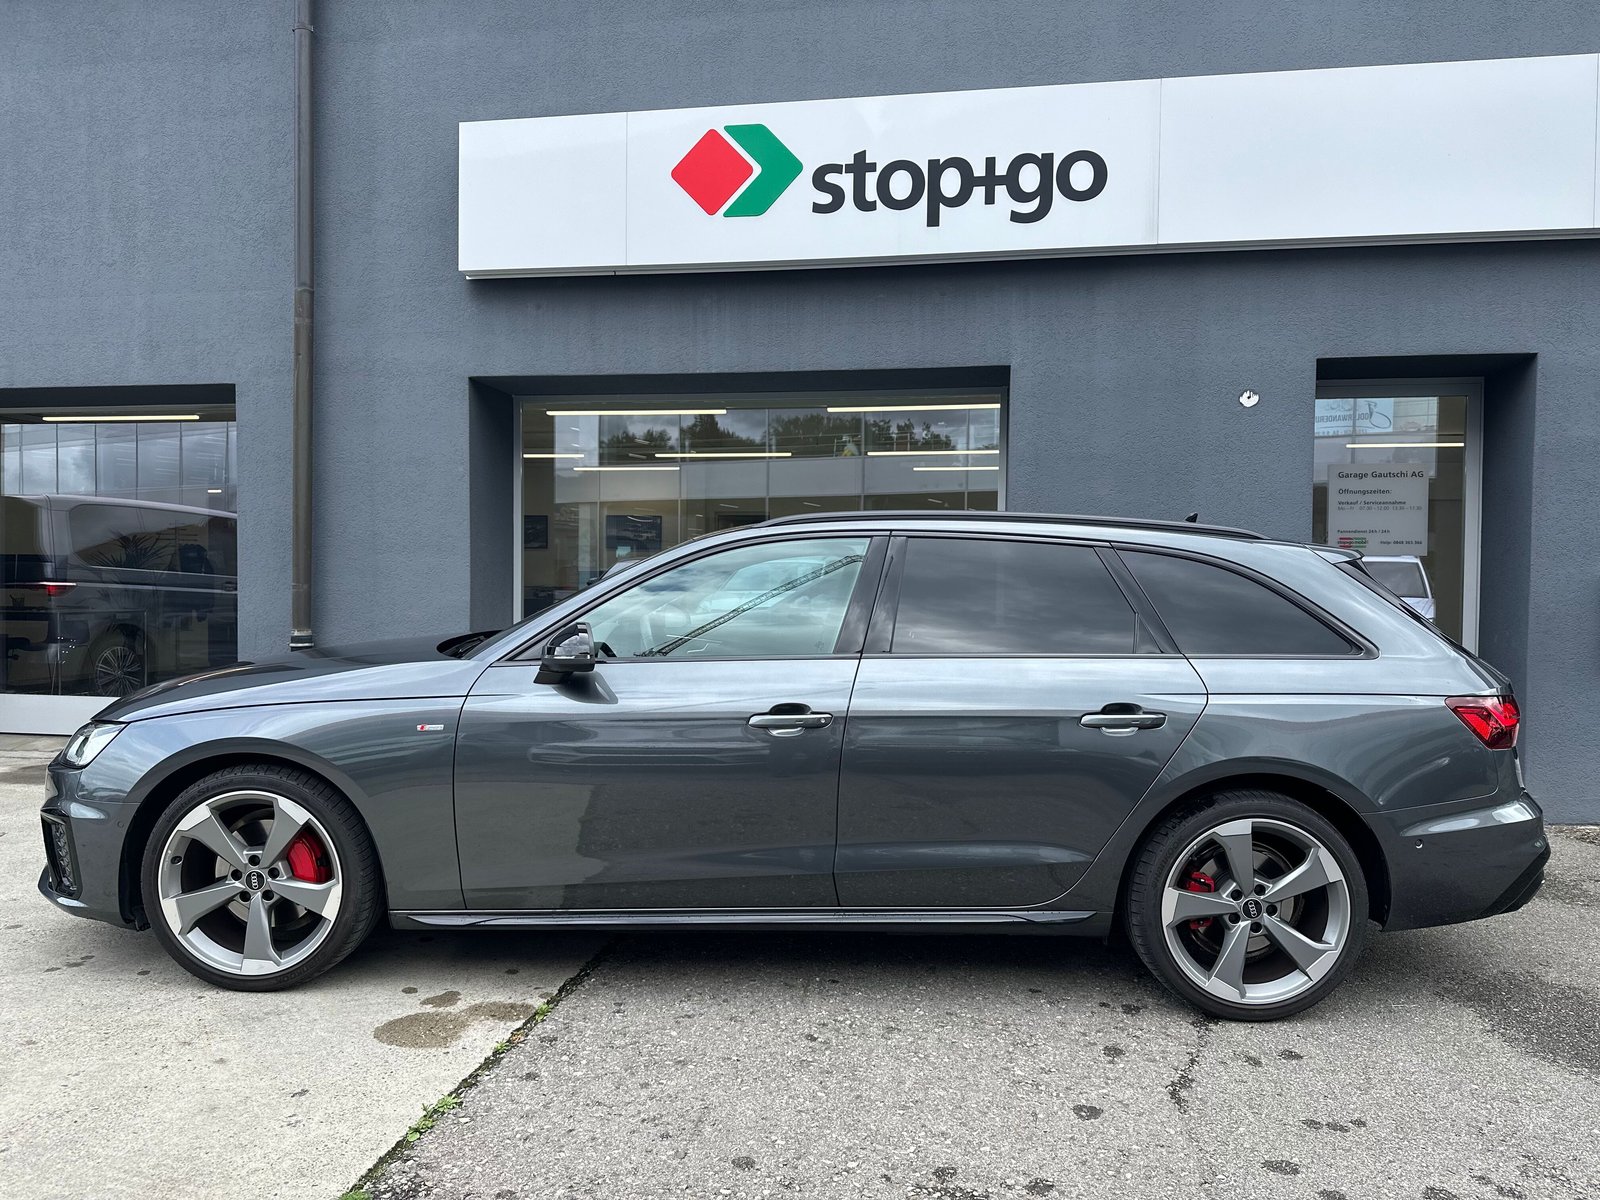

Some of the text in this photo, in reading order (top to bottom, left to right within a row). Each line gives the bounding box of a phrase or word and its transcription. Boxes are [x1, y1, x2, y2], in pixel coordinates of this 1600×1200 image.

[812, 150, 1108, 227] stop+go
[1338, 470, 1424, 480] Garage Gautschi AG
